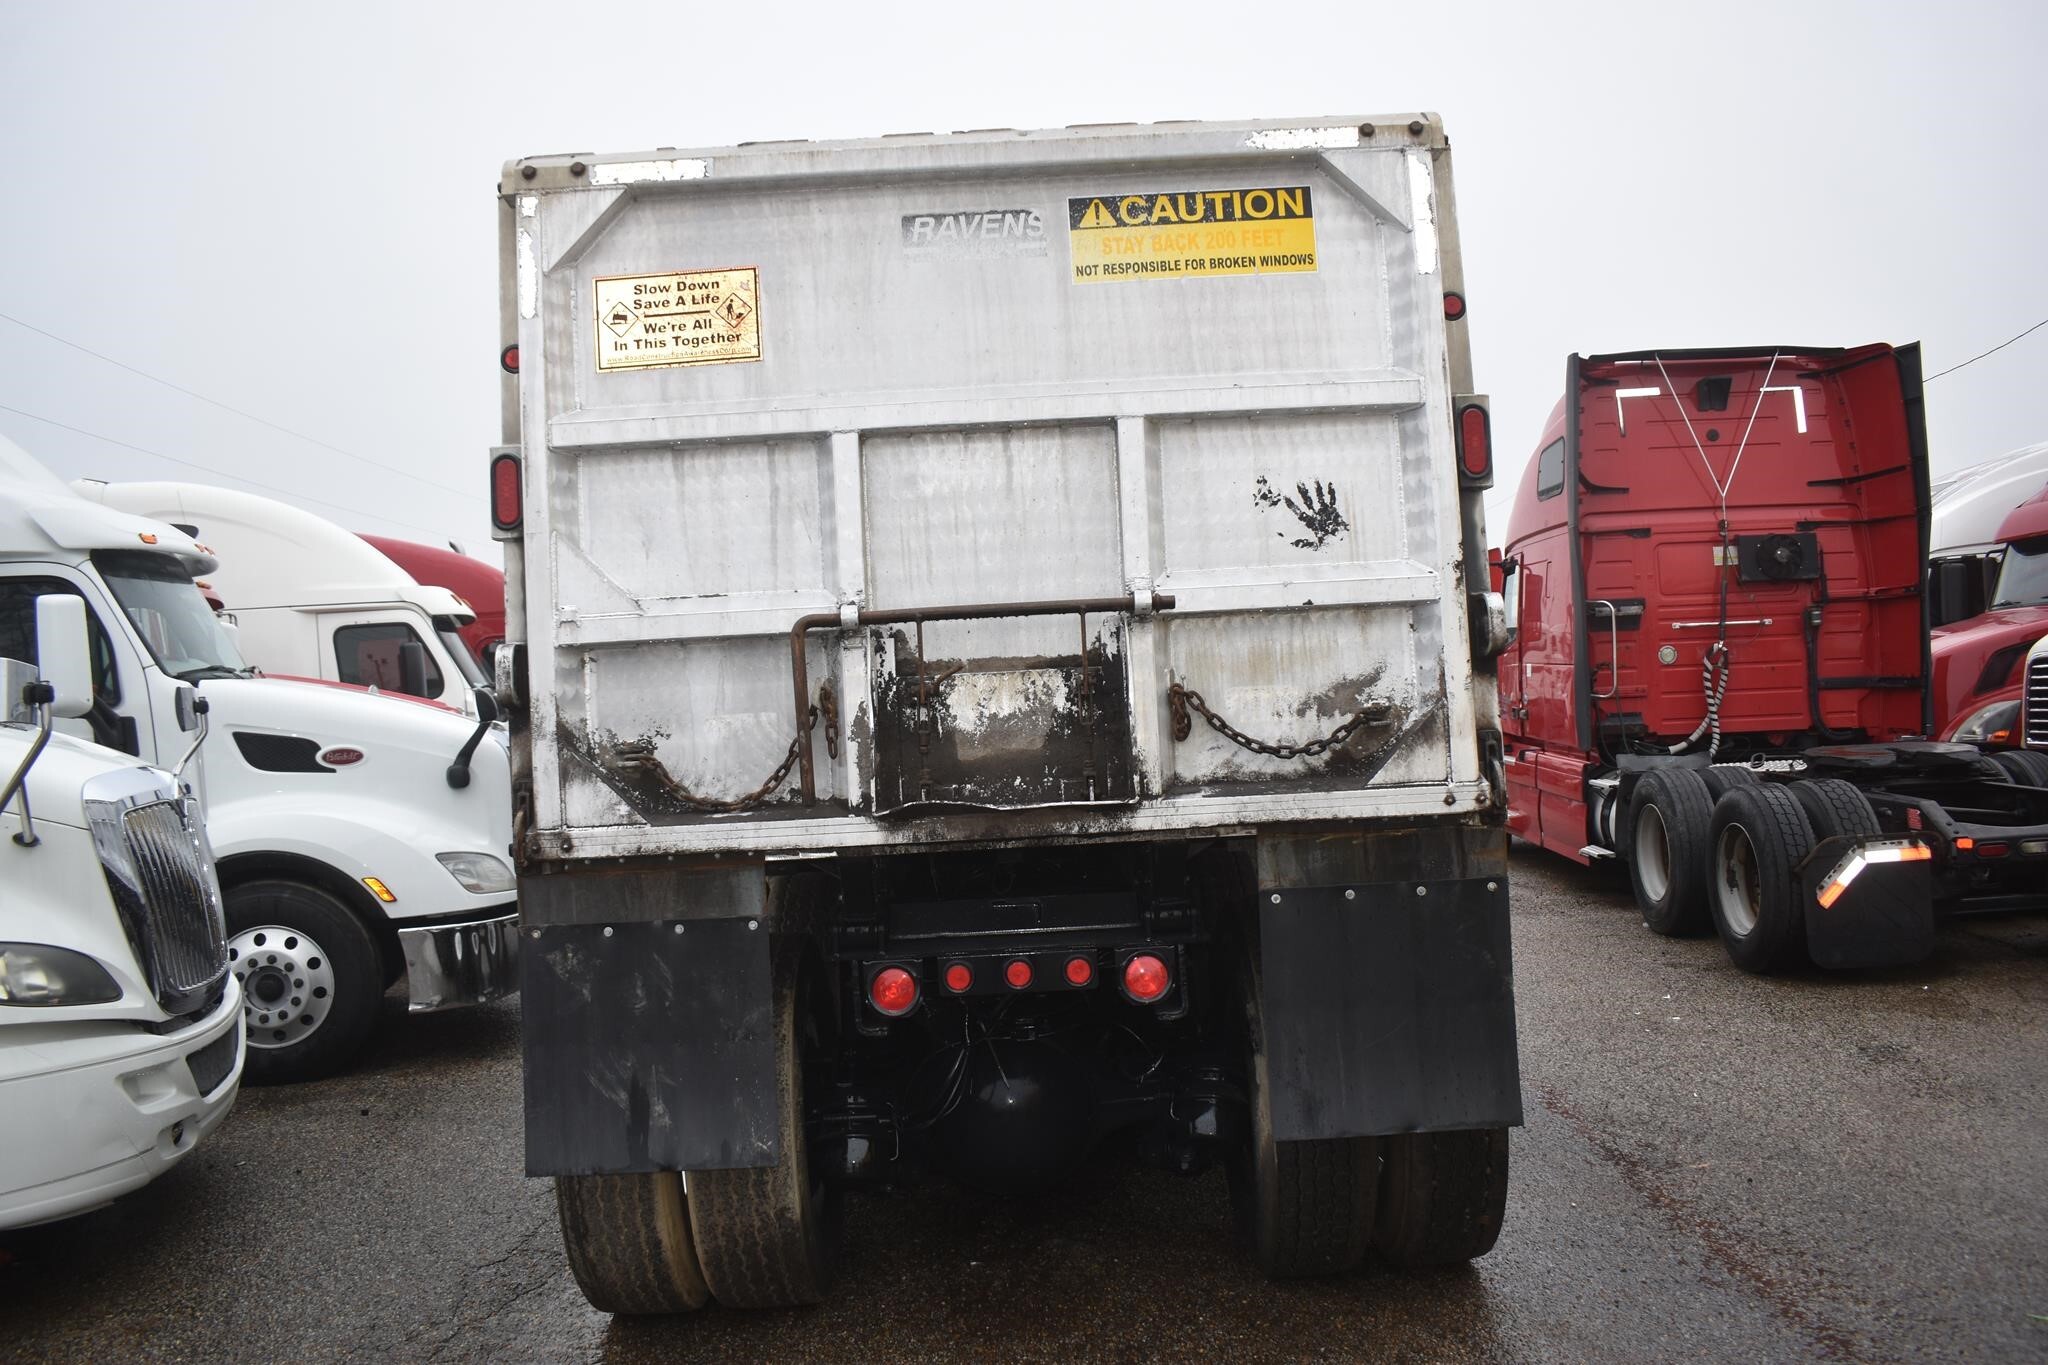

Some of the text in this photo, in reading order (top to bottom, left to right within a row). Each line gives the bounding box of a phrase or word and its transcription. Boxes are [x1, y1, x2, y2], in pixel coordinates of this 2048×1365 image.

[1119, 188, 1304, 225] CAUTION
[912, 208, 1044, 242] RAVENS
[1102, 228, 1285, 256] STAY BACK 200 FEET
[1075, 253, 1315, 277] NOT RESPONSIBLE FOR BROKEN WINDOWS
[633, 280, 720, 295] Slow Down
[633, 294, 720, 310] Save A Life
[643, 318, 712, 334] We're All
[614, 332, 742, 351] In This Together
